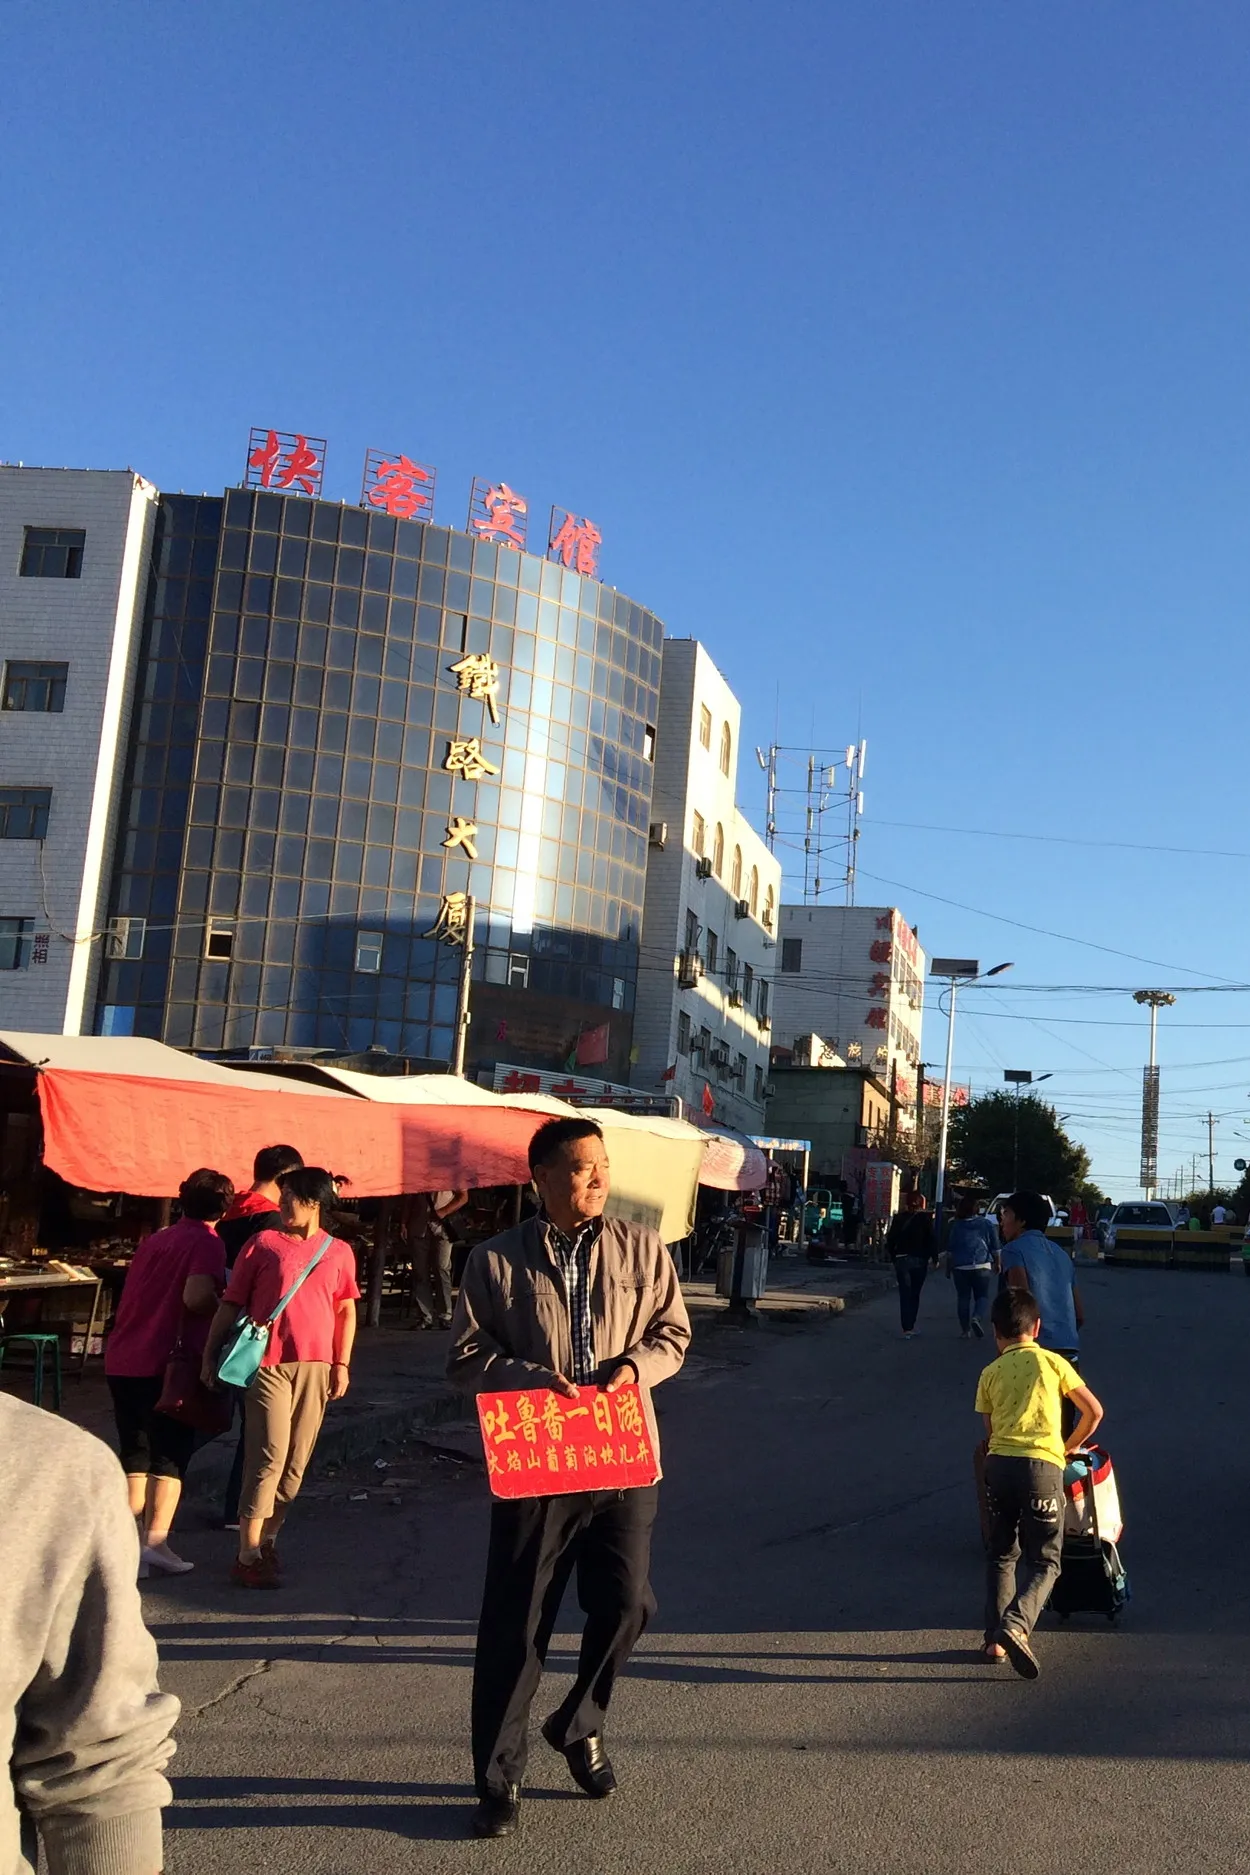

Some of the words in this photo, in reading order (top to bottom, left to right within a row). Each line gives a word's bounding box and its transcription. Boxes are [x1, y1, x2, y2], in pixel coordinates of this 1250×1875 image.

[250, 430, 602, 576] 快客宾馆
[483, 1390, 644, 1444] 吐鲁番一日游
[1031, 1497, 1059, 1513] USA
